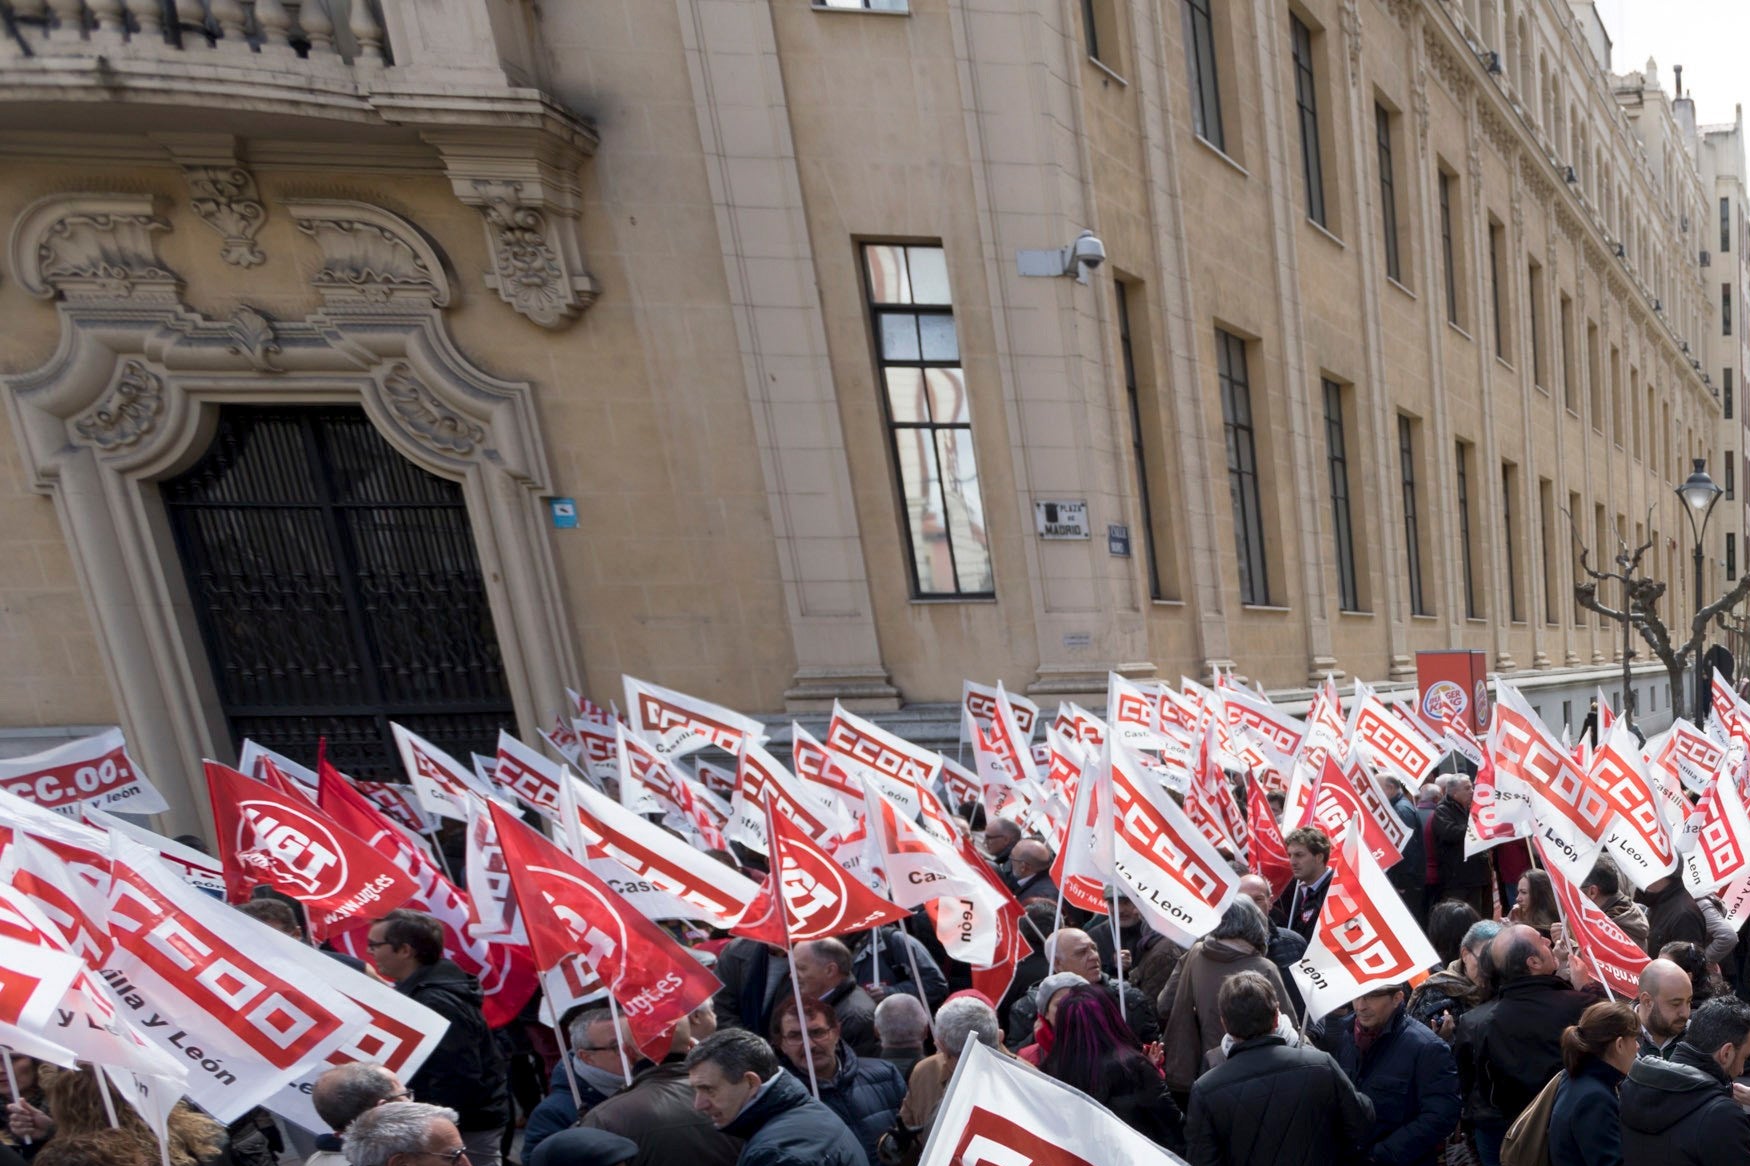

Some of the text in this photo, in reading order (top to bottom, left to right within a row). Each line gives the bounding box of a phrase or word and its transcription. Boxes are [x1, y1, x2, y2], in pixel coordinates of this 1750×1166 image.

[1045, 525, 1082, 535] MADRID
[830, 723, 928, 785] CCOO
[1360, 714, 1425, 773] CCOO
[1497, 720, 1608, 829] CCOO
[1589, 757, 1671, 859] CCOO
[246, 807, 338, 880] UGT
[1545, 827, 1578, 863] León
[1608, 834, 1619, 844] y
[1150, 889, 1193, 925] León
[1322, 884, 1399, 976] COO
[106, 879, 318, 1050] CCOO
[1298, 958, 1328, 990] León
[58, 1008, 74, 1027] y
[141, 1012, 169, 1028] y
[168, 1031, 237, 1085] León
